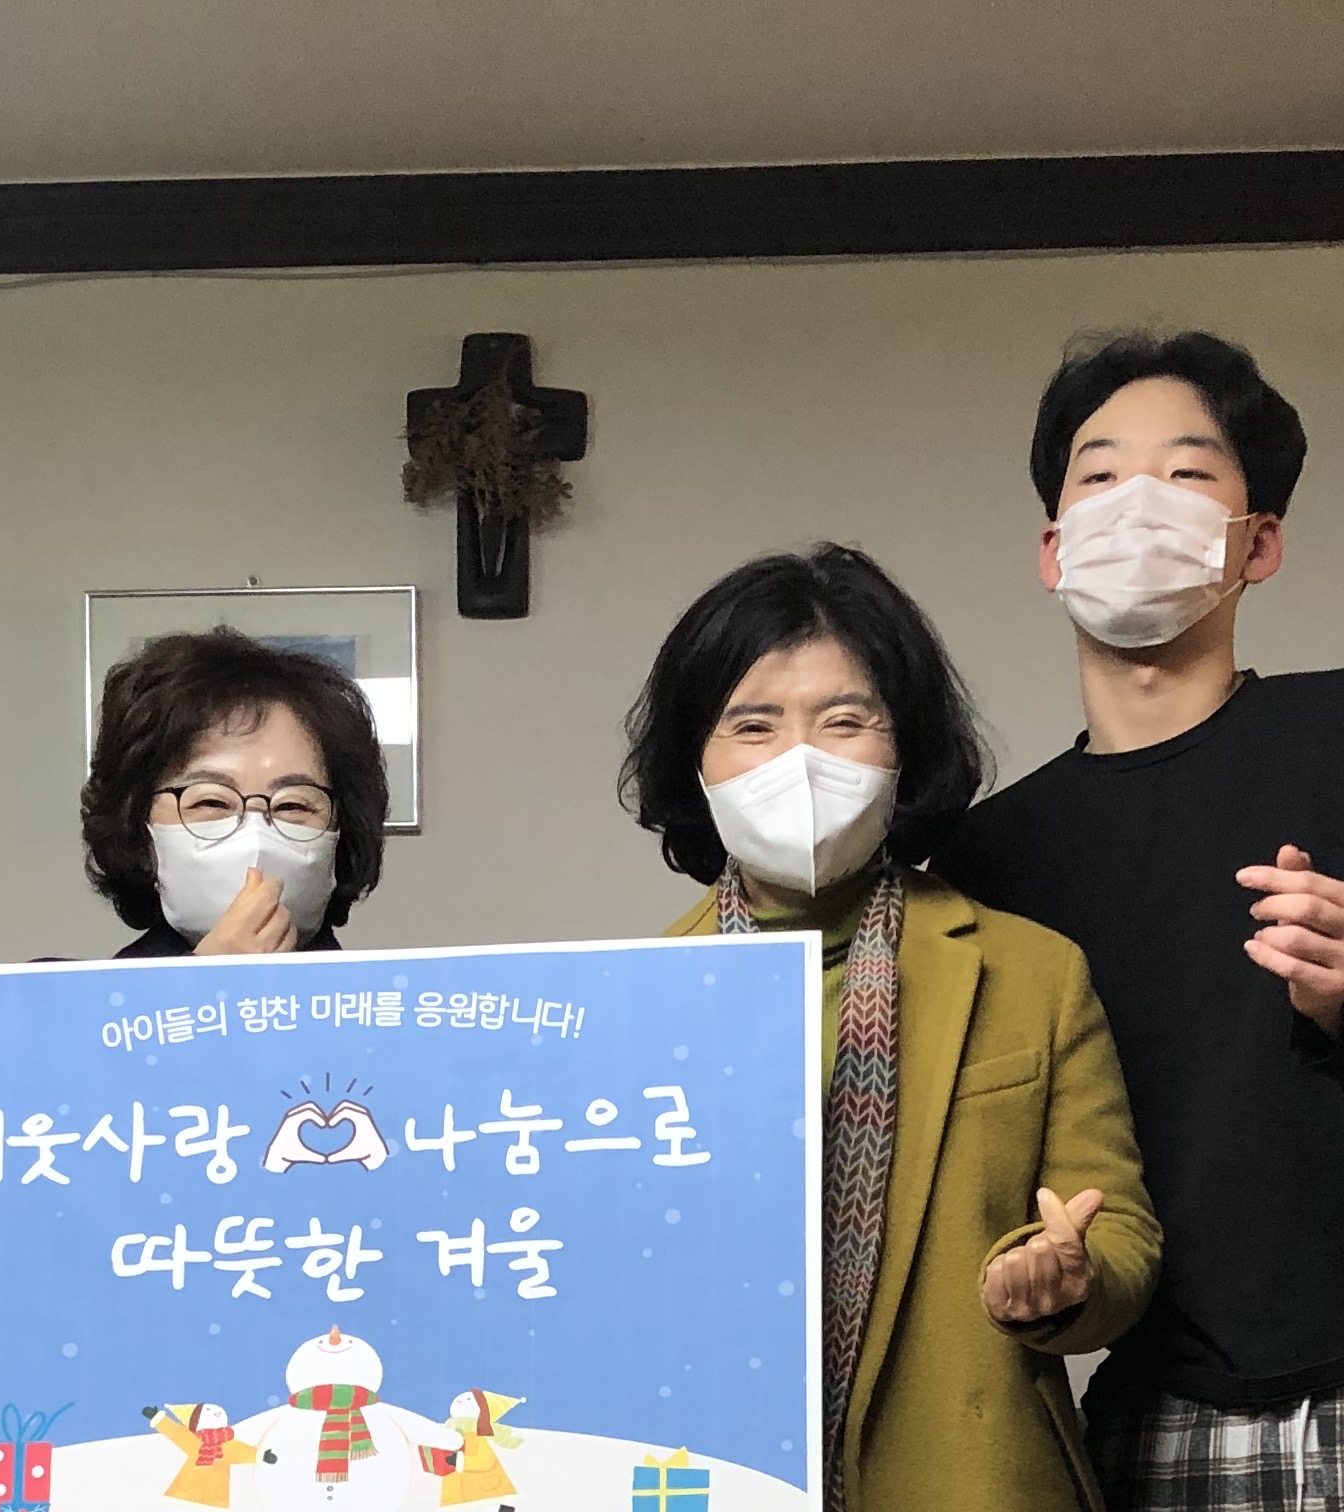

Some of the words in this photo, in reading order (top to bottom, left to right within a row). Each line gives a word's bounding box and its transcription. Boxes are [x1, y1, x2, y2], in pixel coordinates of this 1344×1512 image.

[101, 999, 228, 1052] 아이들의
[236, 994, 301, 1033] 힘찬
[310, 991, 406, 1028] 미래를
[413, 990, 586, 1039] 응원합니다!
[404, 1084, 712, 1176] 나눔으로
[110, 1215, 384, 1303] 따뜻한
[415, 1206, 564, 1300] 겨울
